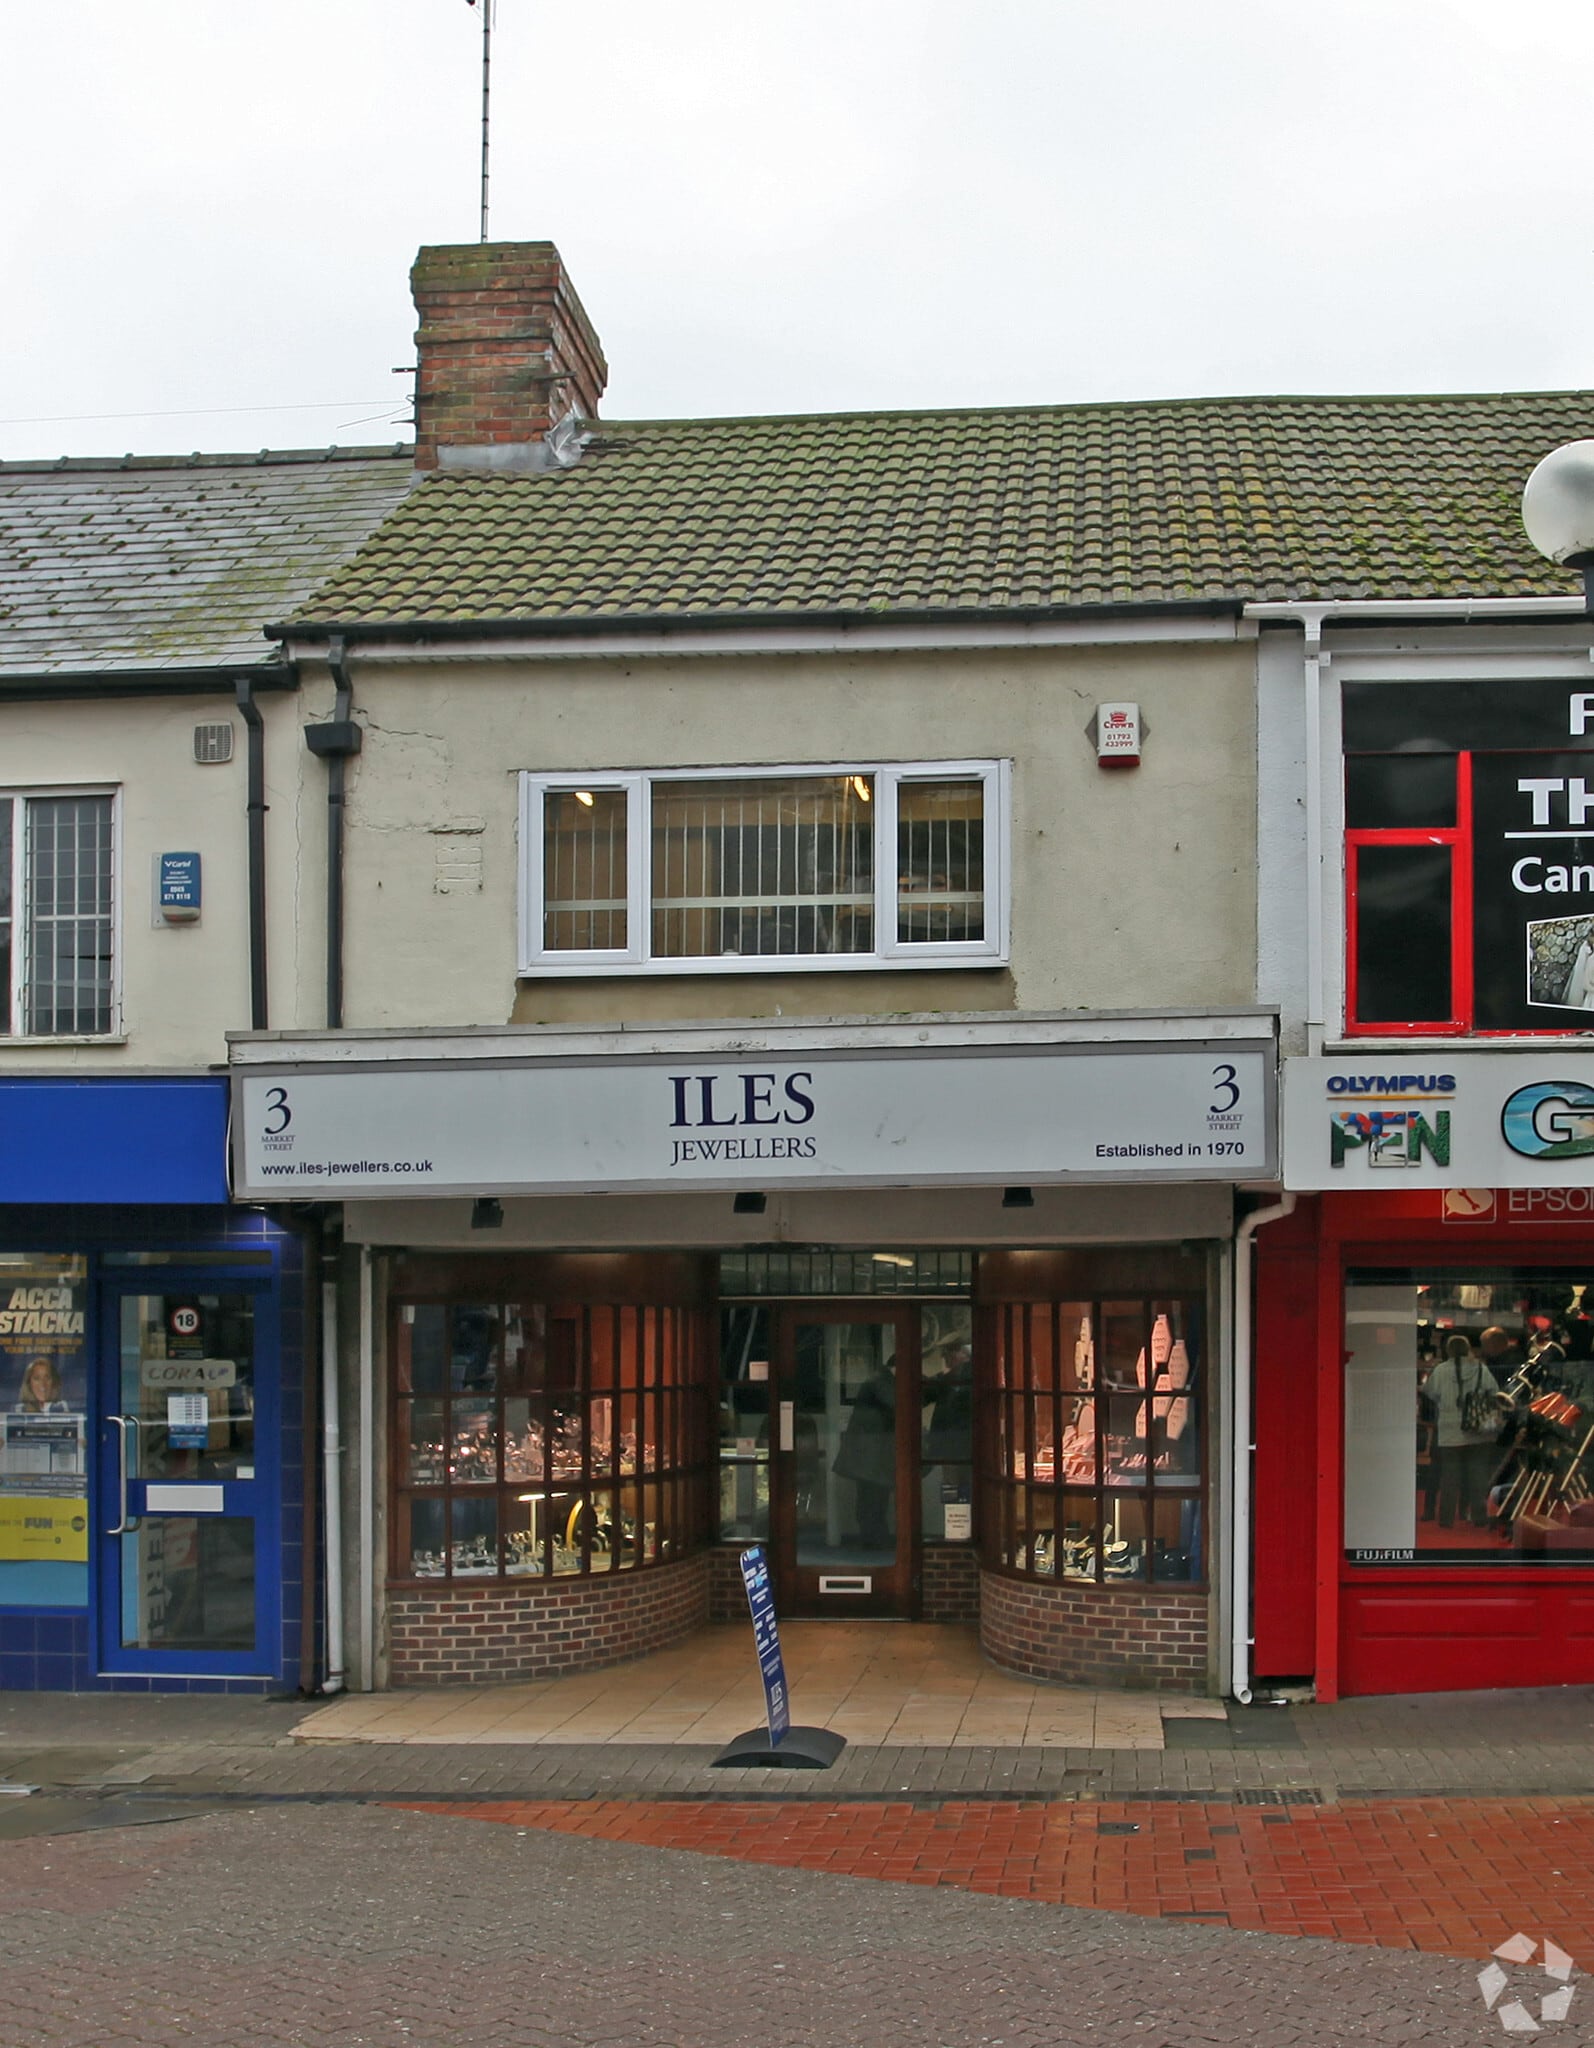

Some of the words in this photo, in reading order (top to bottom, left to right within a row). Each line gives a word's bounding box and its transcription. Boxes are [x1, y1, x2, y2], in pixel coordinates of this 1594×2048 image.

[1103, 721, 1134, 729] Crown
[1210, 1064, 1240, 1114] 3
[1327, 1074, 1456, 1094] OLYMPUS
[668, 1072, 815, 1127] ILES
[264, 1087, 292, 1135] 3
[1206, 1114, 1244, 1122] MARKET
[1209, 1123, 1241, 1131] STREET
[261, 1135, 296, 1143] MARKET
[264, 1143, 293, 1151] STREET
[1331, 1110, 1451, 1168] PEN
[670, 1136, 817, 1167] JEWELLERS
[1096, 1144, 1183, 1157] Established
[1188, 1143, 1201, 1156] in
[1207, 1142, 1245, 1156] 1970
[261, 1160, 433, 1176] www.iles-jewellers.co.uk
[1508, 1189, 1594, 1212] EPSO
[8, 1288, 73, 1310] ACCA
[0, 1312, 85, 1334] STACKA
[176, 1313, 195, 1327] 18
[24, 1517, 53, 1529] FUN
